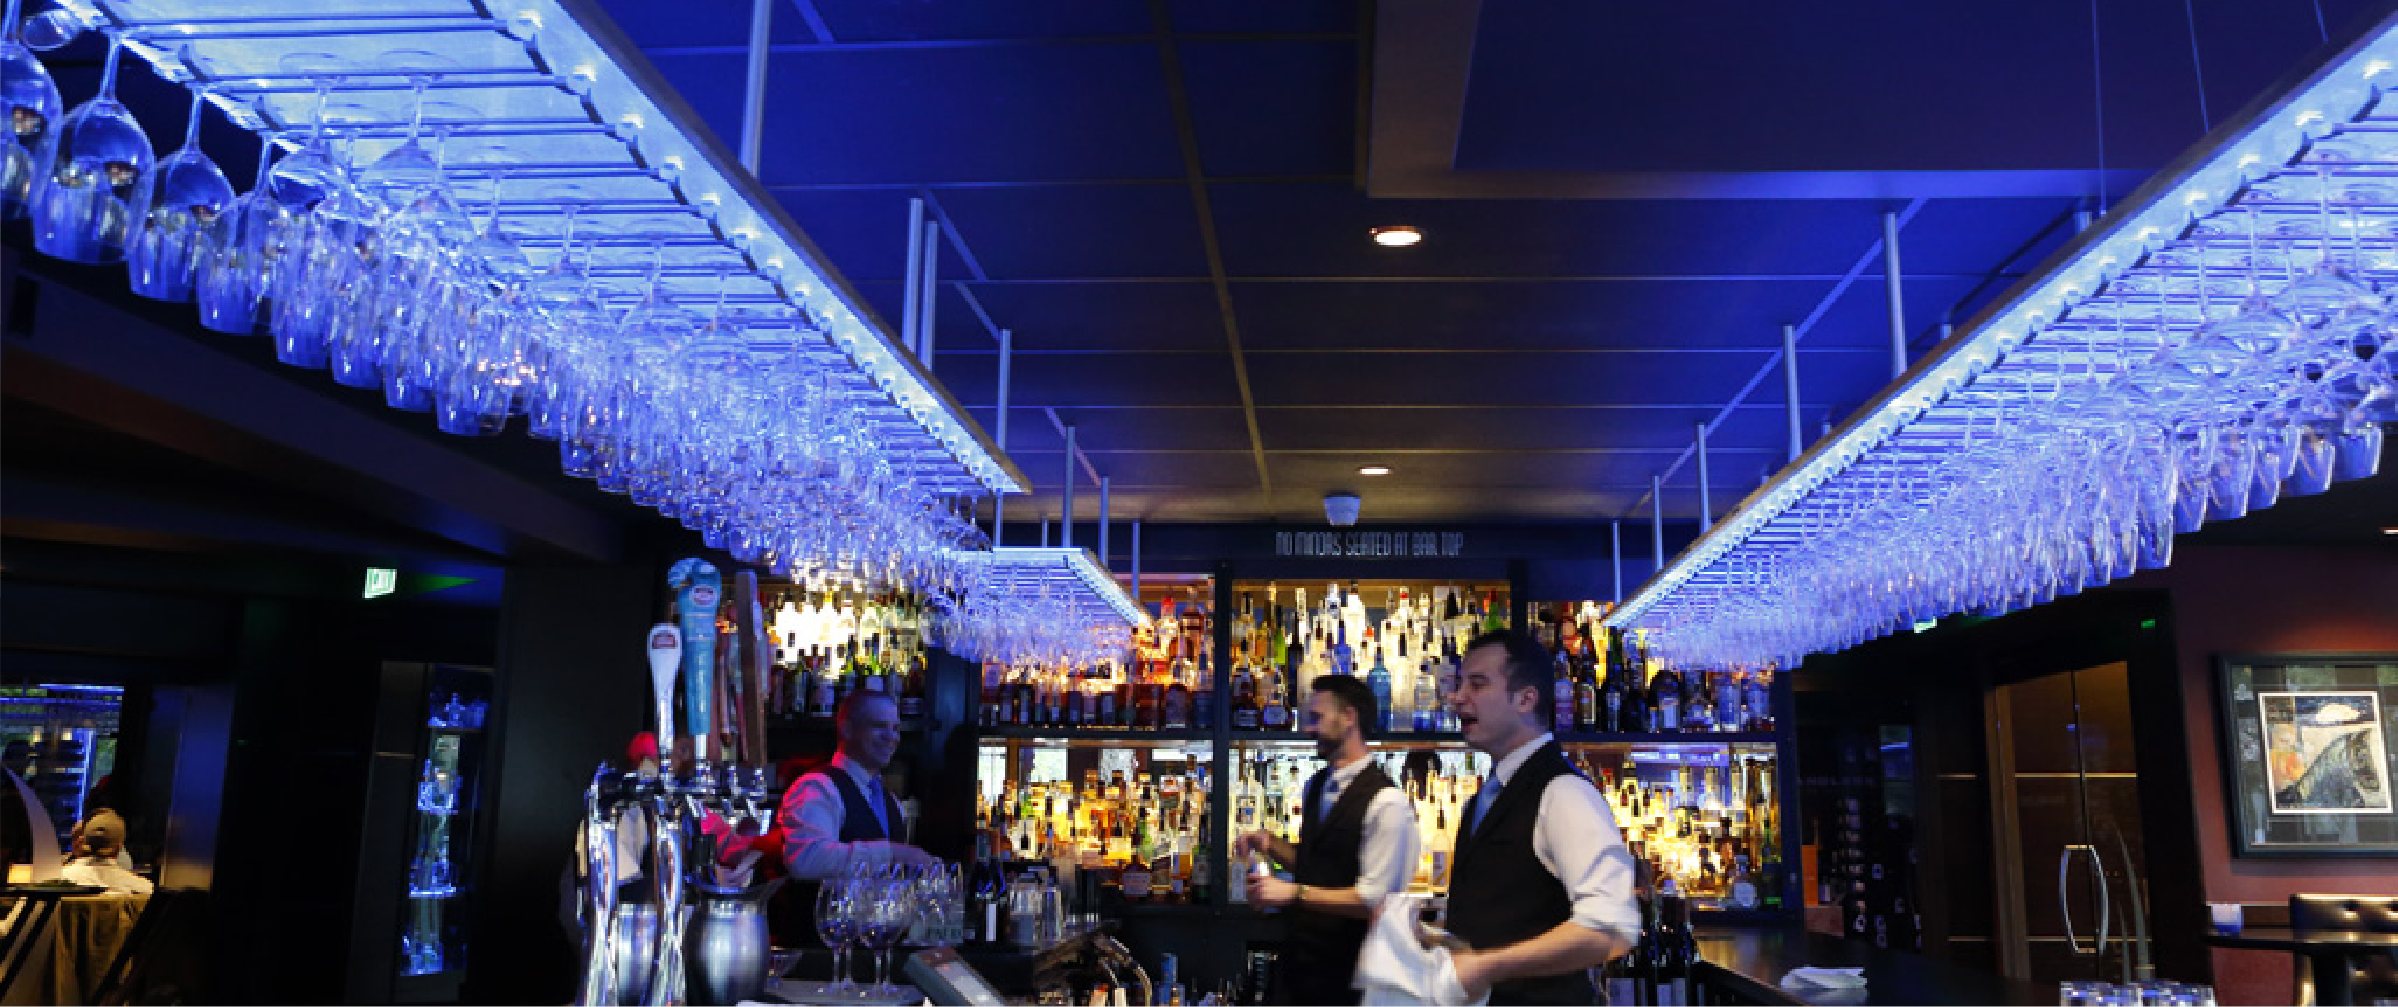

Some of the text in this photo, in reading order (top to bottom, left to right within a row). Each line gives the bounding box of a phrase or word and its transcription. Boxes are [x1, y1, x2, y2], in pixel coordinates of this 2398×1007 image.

[1276, 532, 1463, 555] NO MINORS SEATED AT BAR TOP
